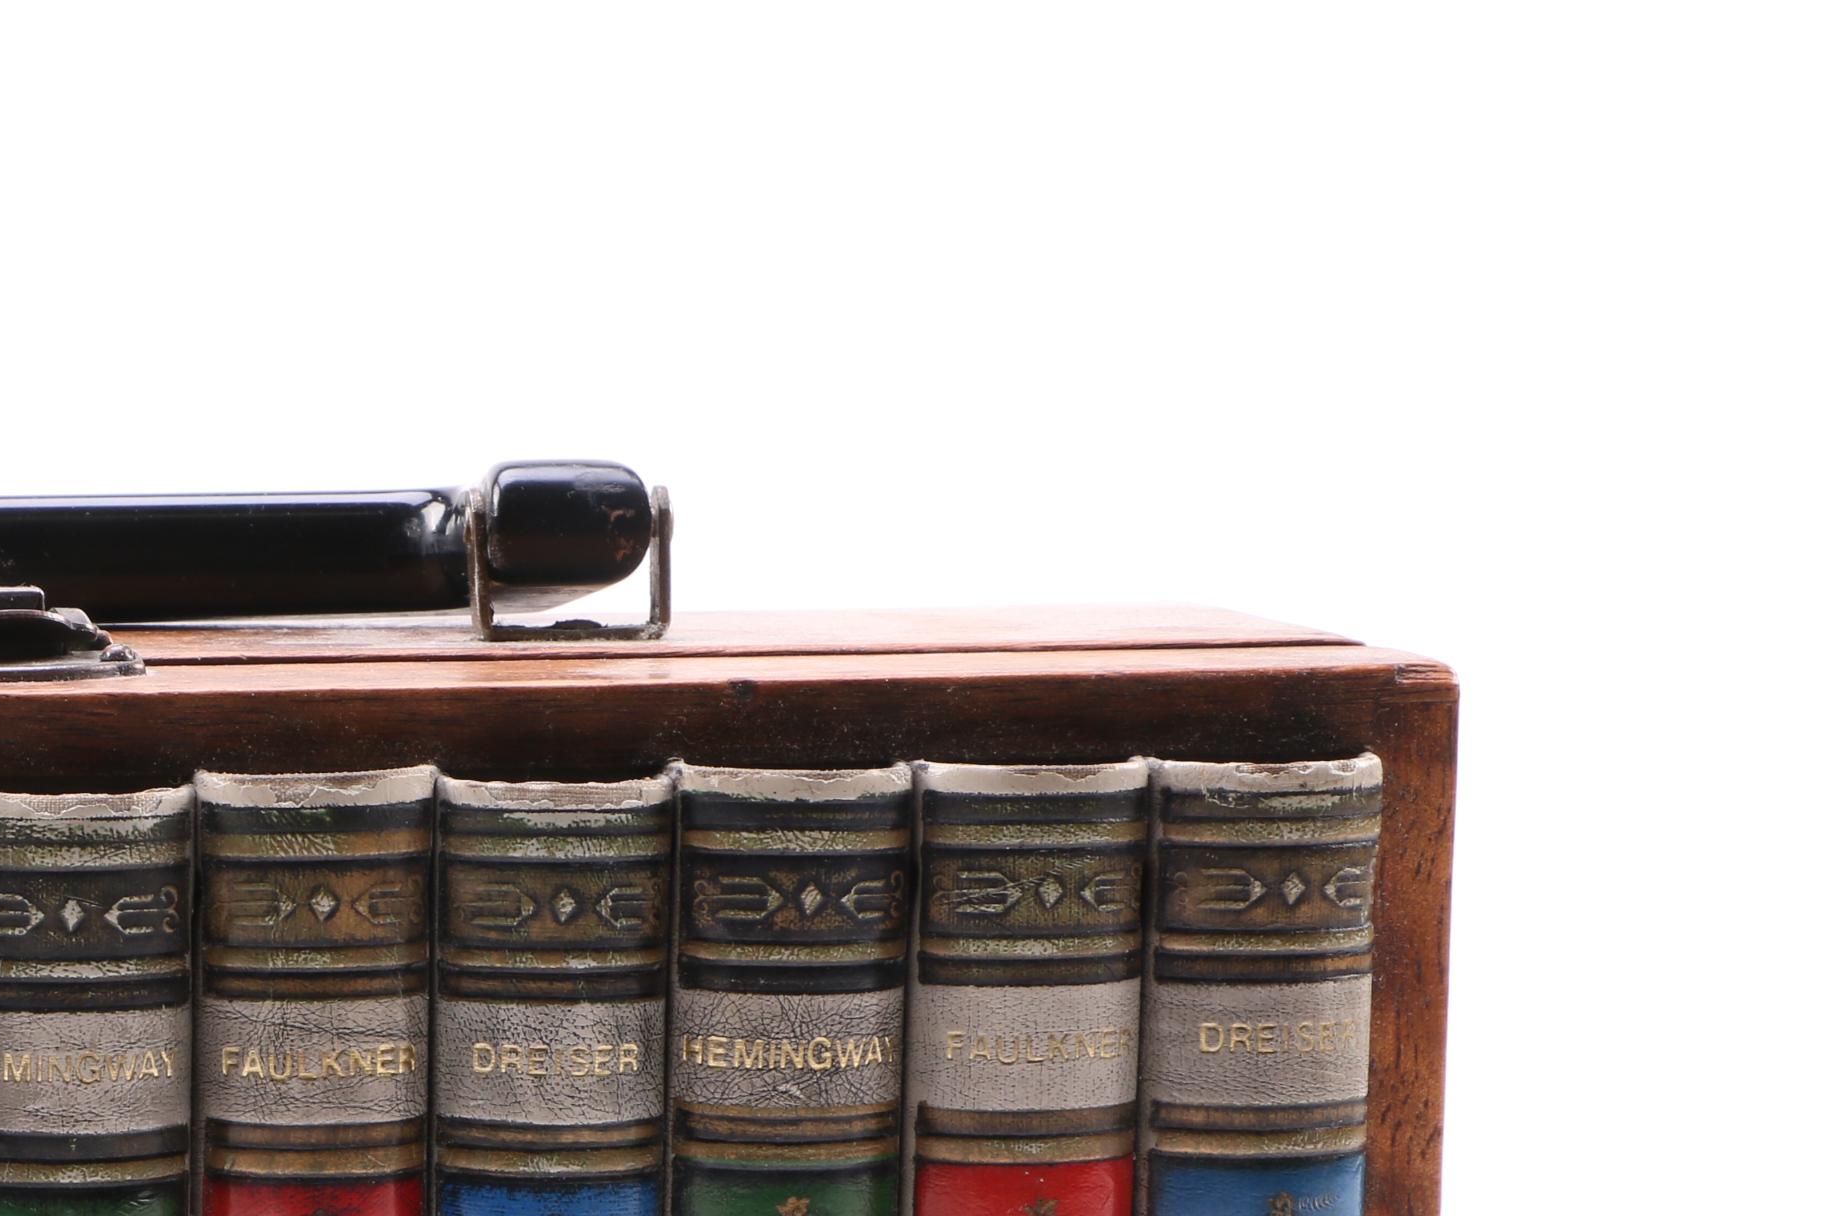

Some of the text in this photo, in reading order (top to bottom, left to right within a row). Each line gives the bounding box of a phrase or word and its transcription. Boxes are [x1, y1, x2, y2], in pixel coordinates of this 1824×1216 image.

[945, 1028, 1139, 1066] FAULKNER
[1199, 1021, 1359, 1055] DREISER
[221, 1042, 418, 1082] FAULKNER
[474, 1041, 640, 1077] DREISER
